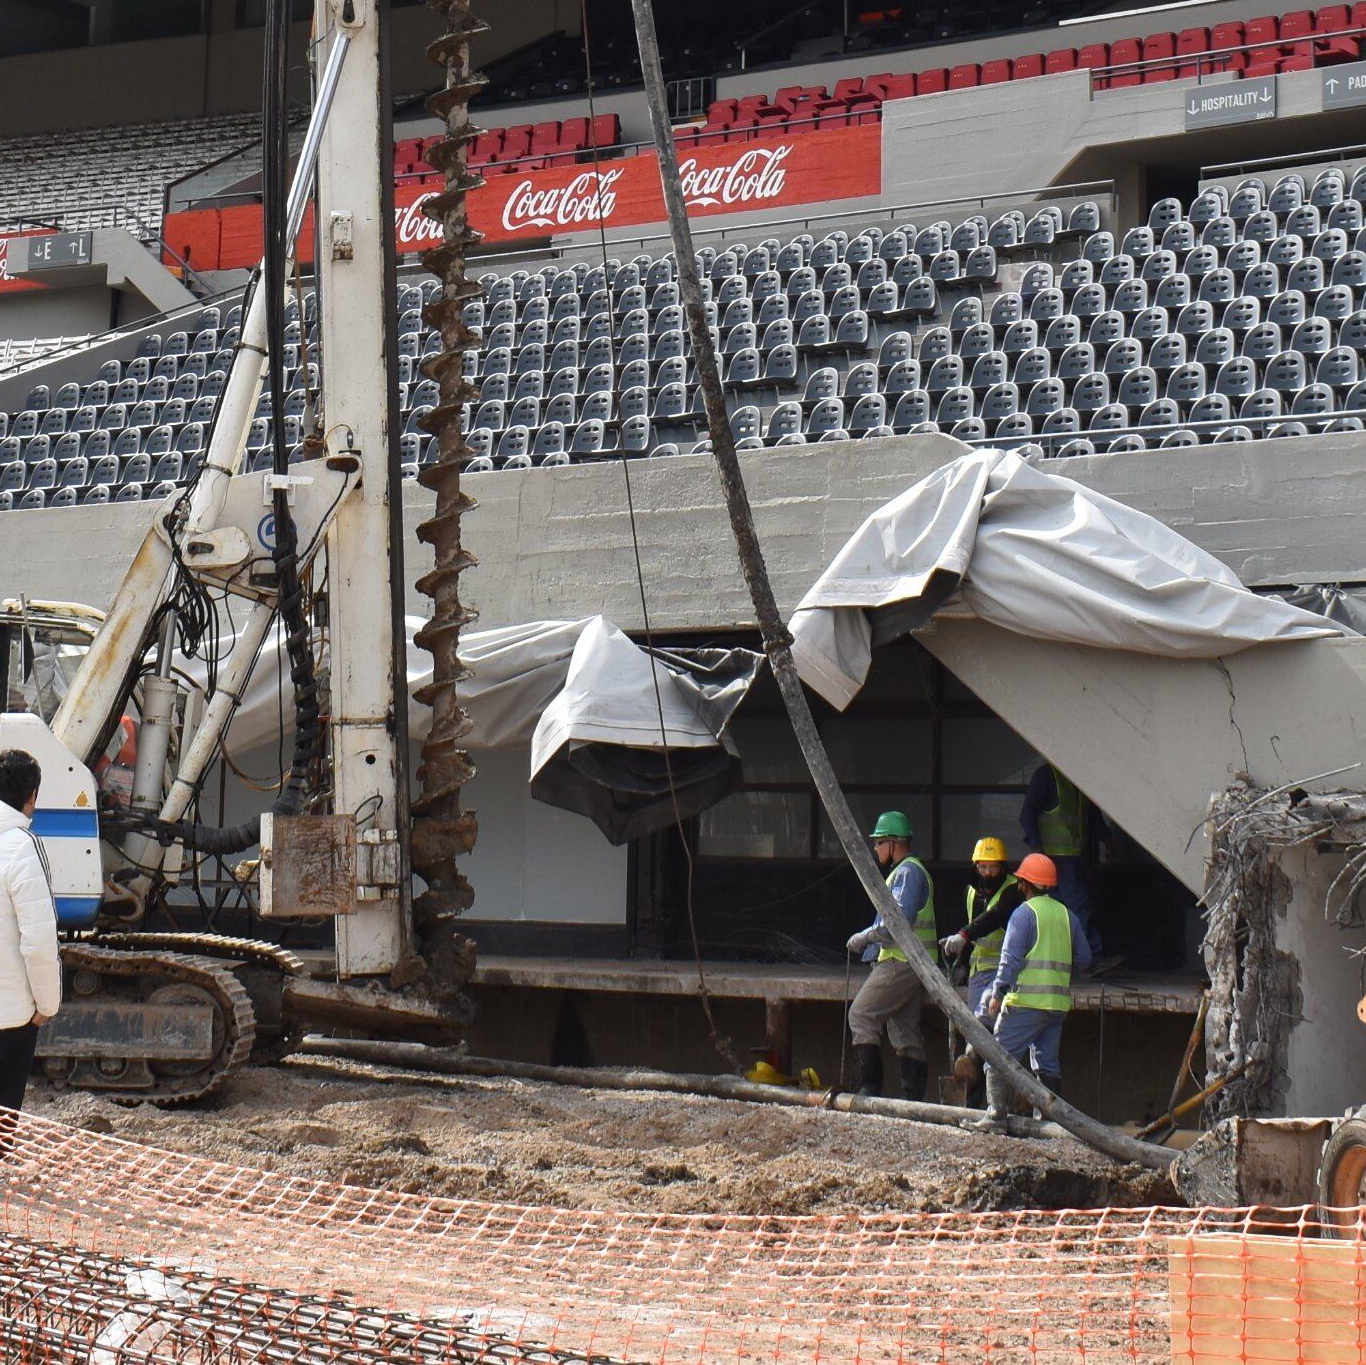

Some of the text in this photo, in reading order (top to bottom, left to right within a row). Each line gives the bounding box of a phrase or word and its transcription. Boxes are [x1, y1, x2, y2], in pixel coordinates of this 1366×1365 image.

[1201, 91, 1259, 112] HOSPITALITY
[502, 167, 625, 232] Coca-Cola
[44, 238, 86, 261] E L
